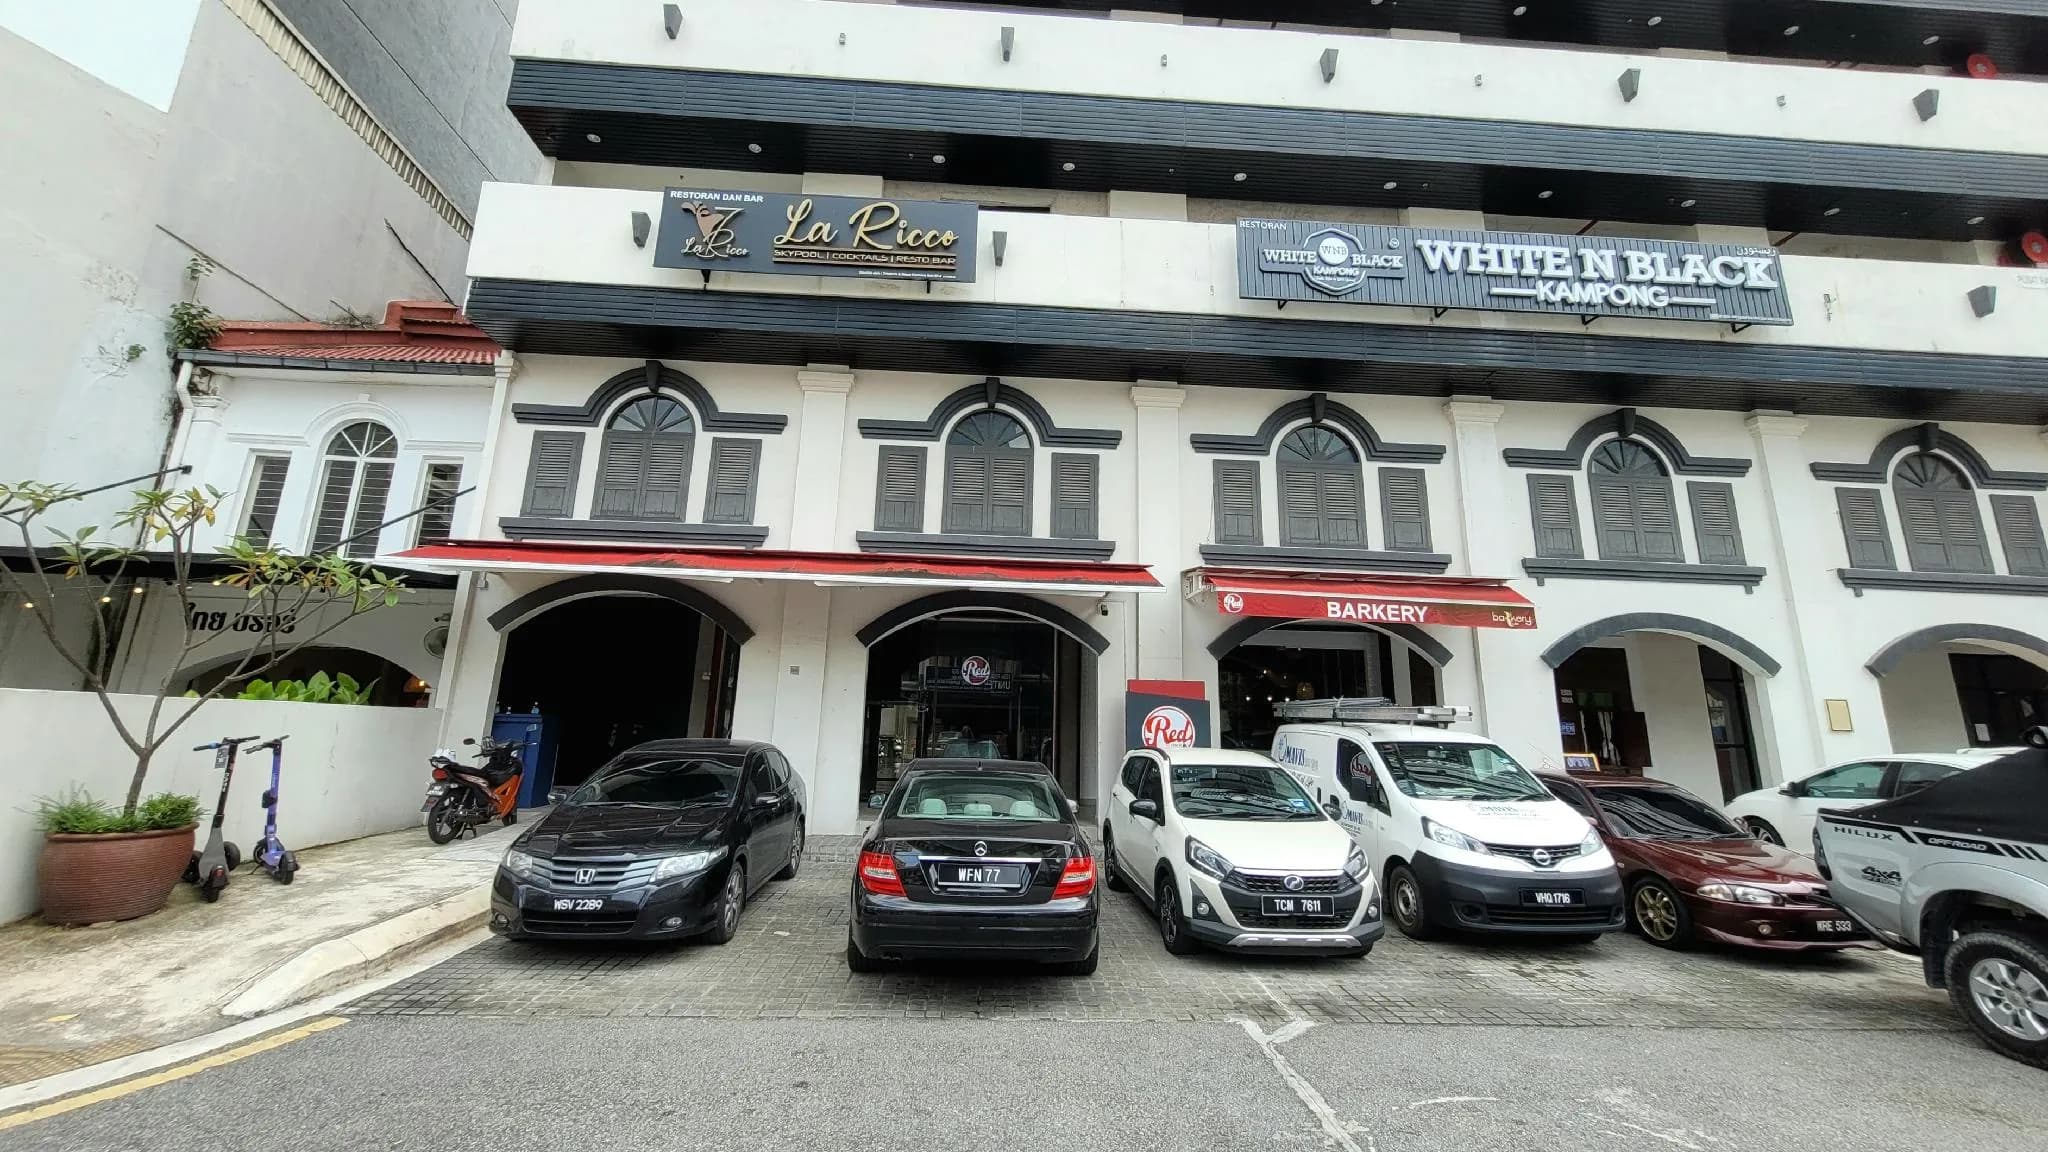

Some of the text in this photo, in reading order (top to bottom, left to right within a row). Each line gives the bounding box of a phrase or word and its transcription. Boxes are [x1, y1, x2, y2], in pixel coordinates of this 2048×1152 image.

[670, 190, 764, 203] RESTORAN DAN BAR
[773, 199, 960, 250] La Ricco
[1239, 220, 1287, 230] RESTORAN
[774, 249, 956, 264] SKYPOOL COCKTAILS RESTO BAR
[1264, 249, 1317, 264] WHITE
[1351, 253, 1404, 268] BLACK
[1313, 265, 1359, 277] KAMPONG
[1416, 239, 1778, 290] WHITE N BLACK
[1535, 280, 1671, 308] KAMPONG
[1327, 601, 1429, 623] BARKERY
[962, 659, 989, 682] Red
[1145, 715, 1192, 748] Red
[1834, 826, 1893, 841] HILUX
[958, 868, 1001, 883] WFN 77
[554, 899, 603, 911] WSV 2289
[1274, 899, 1321, 912] TCM 7611
[1835, 920, 1851, 932] 533
